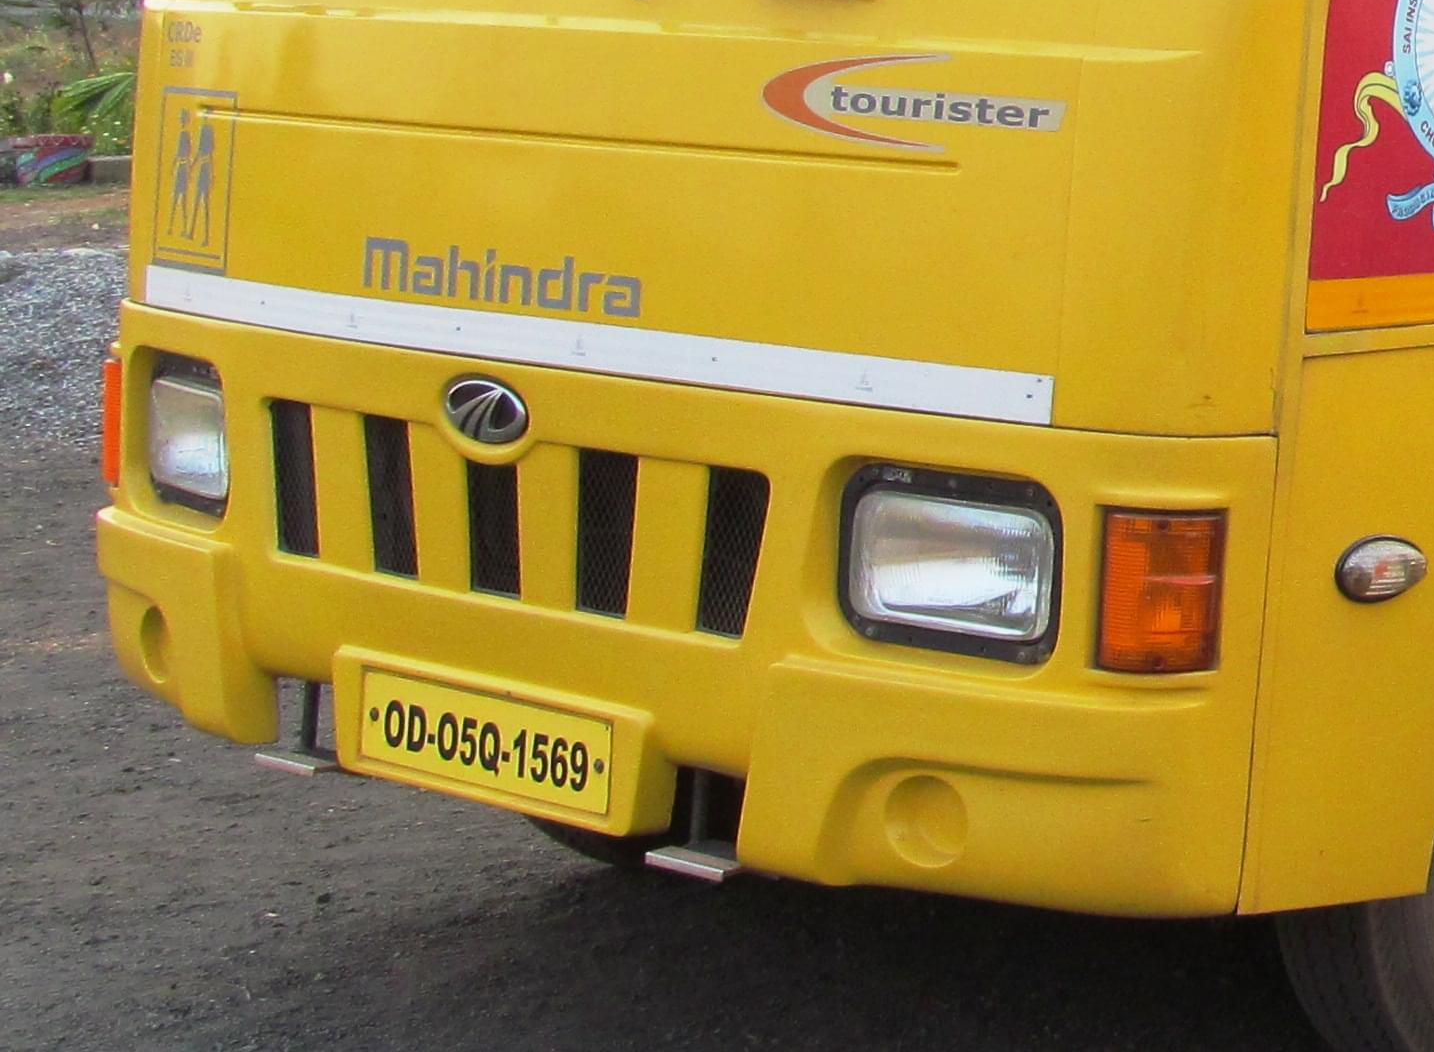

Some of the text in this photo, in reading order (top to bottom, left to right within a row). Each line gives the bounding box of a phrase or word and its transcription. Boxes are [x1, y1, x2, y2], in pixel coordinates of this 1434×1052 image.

[1403, 28, 1412, 54] SAI
[831, 85, 1051, 128] tourister
[363, 236, 642, 318] Mahindra
